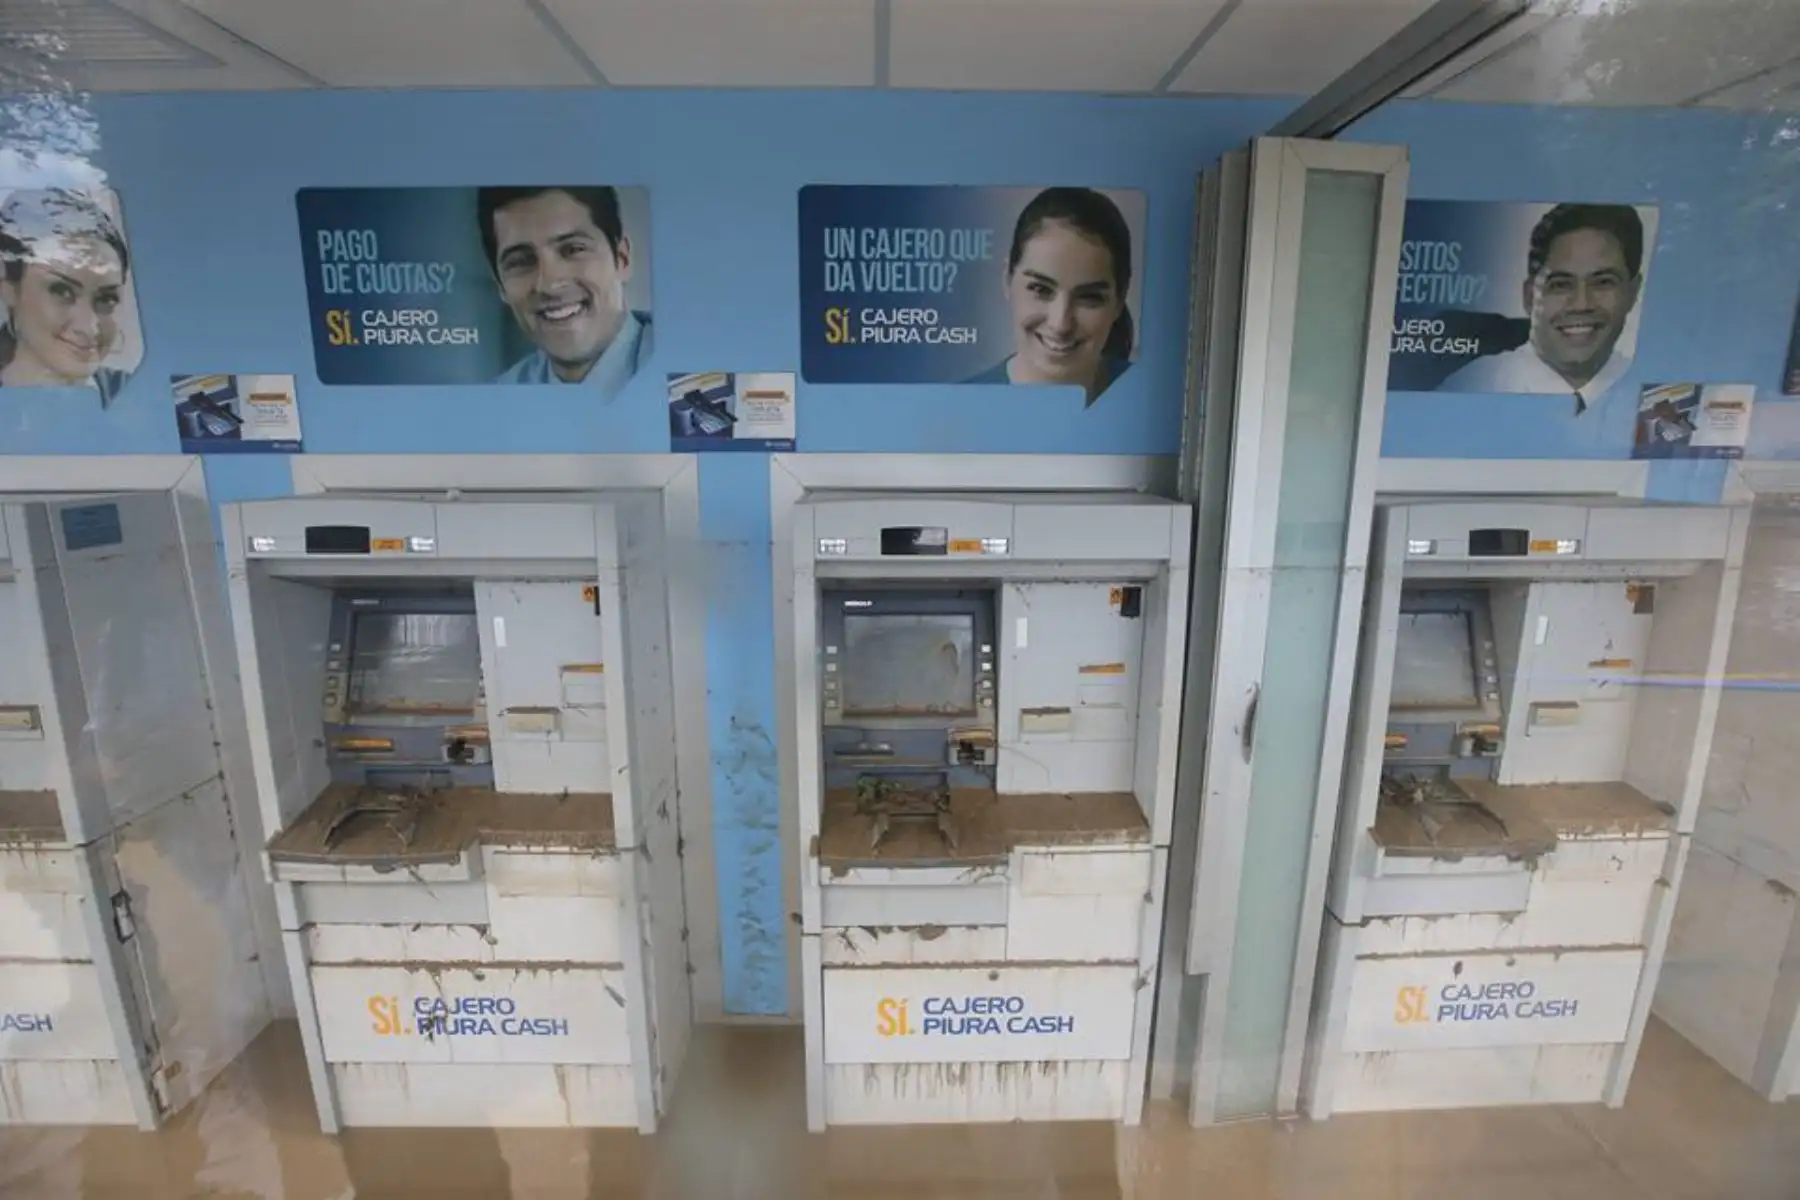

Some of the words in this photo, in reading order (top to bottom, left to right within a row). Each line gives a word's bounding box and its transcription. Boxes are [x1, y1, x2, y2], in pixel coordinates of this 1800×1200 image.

[317, 229, 378, 261] PAGO
[824, 227, 855, 259] UN
[860, 227, 945, 260] CAJERO
[950, 228, 994, 261] QUE
[322, 263, 353, 294] DE
[356, 262, 455, 294] CUOTAS?
[824, 261, 855, 292] DA
[859, 261, 957, 292] VUELTO?
[361, 309, 439, 327] CAJERO
[860, 308, 938, 326] CAJERO
[364, 328, 425, 345] PIURA
[427, 328, 479, 344] CASH
[861, 327, 920, 344] PIURA
[924, 327, 978, 344] CASH
[1394, 319, 1445, 336] JERO
[1429, 337, 1479, 355] CASH
[1441, 982, 1535, 1001] CAJERO
[414, 997, 515, 1015] CAJERO
[923, 996, 1024, 1015] CAJERO
[1437, 1003, 1509, 1022] PIURA
[1515, 1000, 1579, 1019] CASH
[417, 1017, 498, 1036] PIURA
[501, 1018, 568, 1036] CASH
[923, 1017, 1001, 1035] PIURA
[1005, 1015, 1074, 1034] CASH
